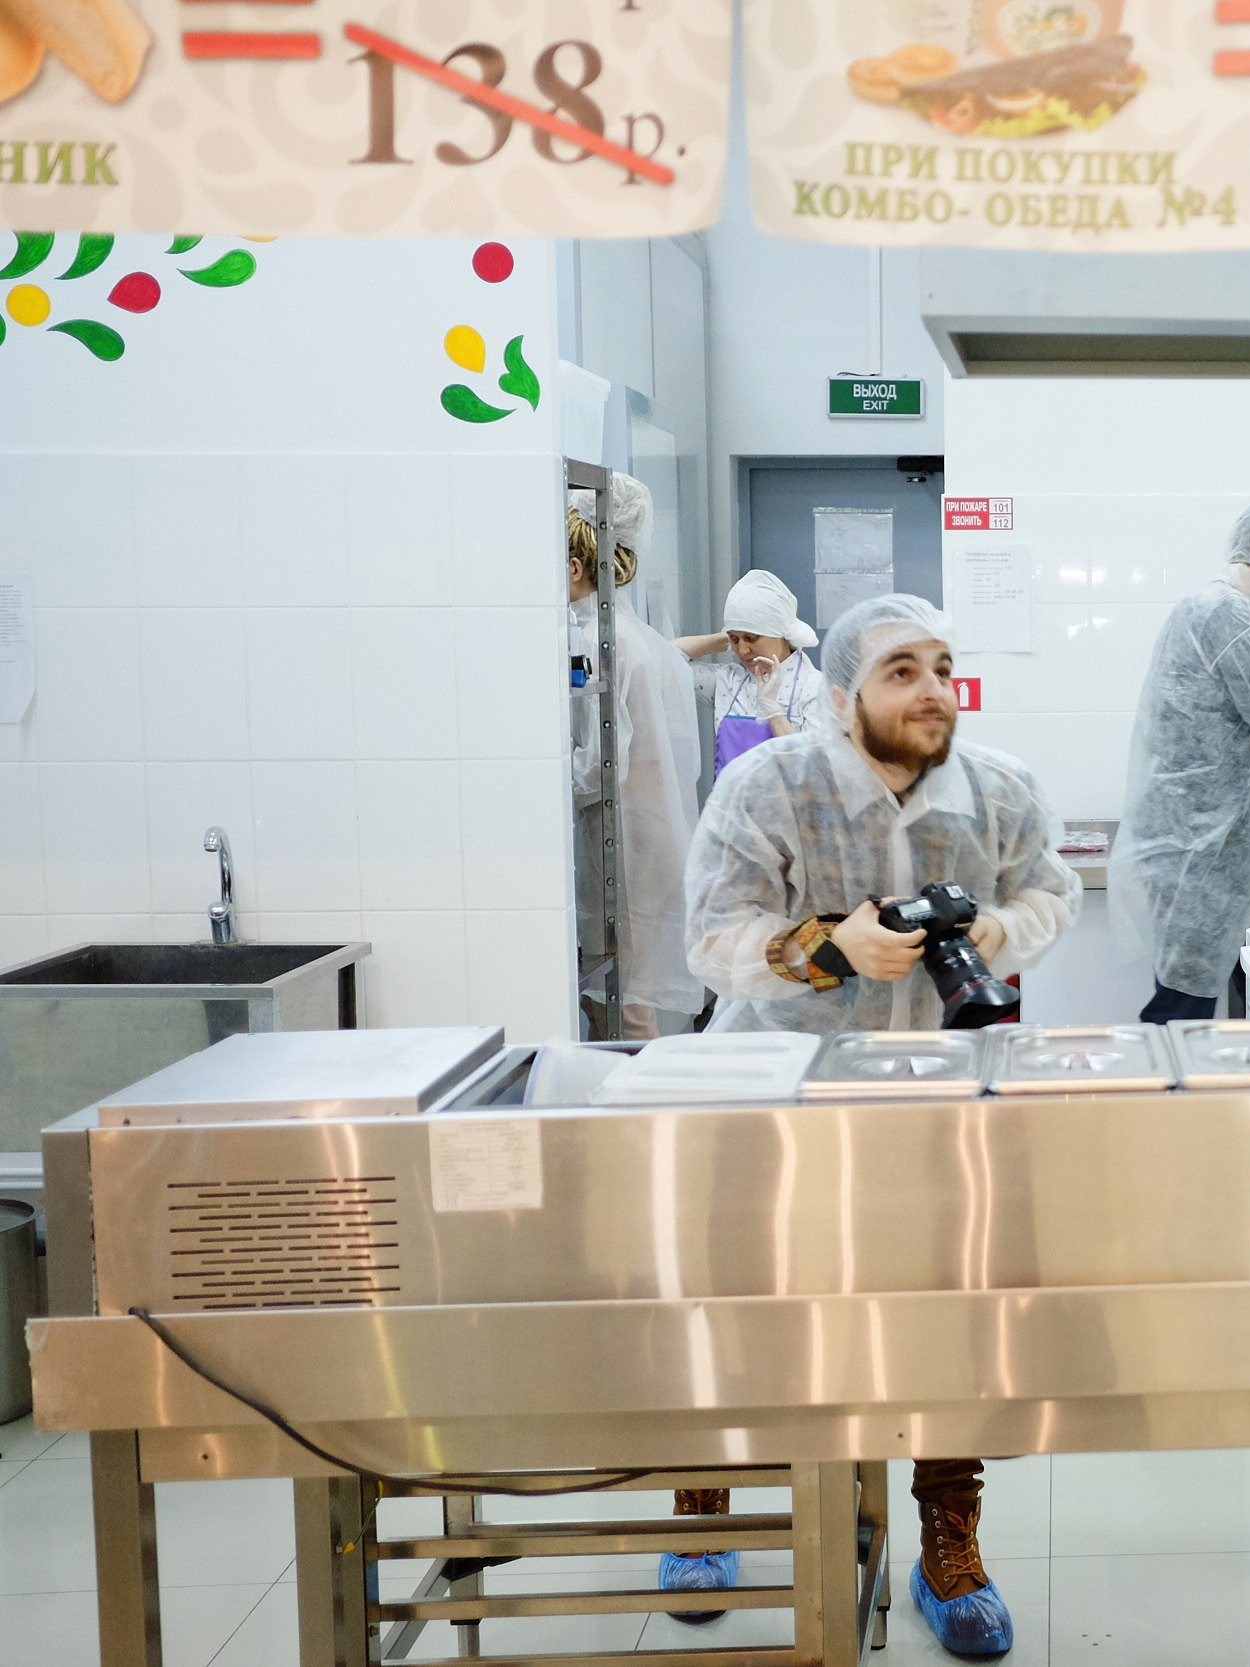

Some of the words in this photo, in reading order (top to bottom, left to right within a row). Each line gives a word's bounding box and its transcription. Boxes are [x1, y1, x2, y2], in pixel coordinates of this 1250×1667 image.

[844, 142, 938, 179] ПРИ
[954, 147, 1176, 185] ПОКУПКИ
[984, 192, 1133, 233] ОБЕДА
[1156, 184, 1237, 229] №4
[853, 383, 897, 400] ВЫХОД
[863, 400, 889, 410] EXIT
[946, 501, 959, 512] ПРИ
[960, 501, 987, 512] ПОЖАРЕ
[993, 503, 1009, 512] 101
[951, 515, 982, 526] ЗВОНИТЬ
[993, 518, 1009, 528] 112
